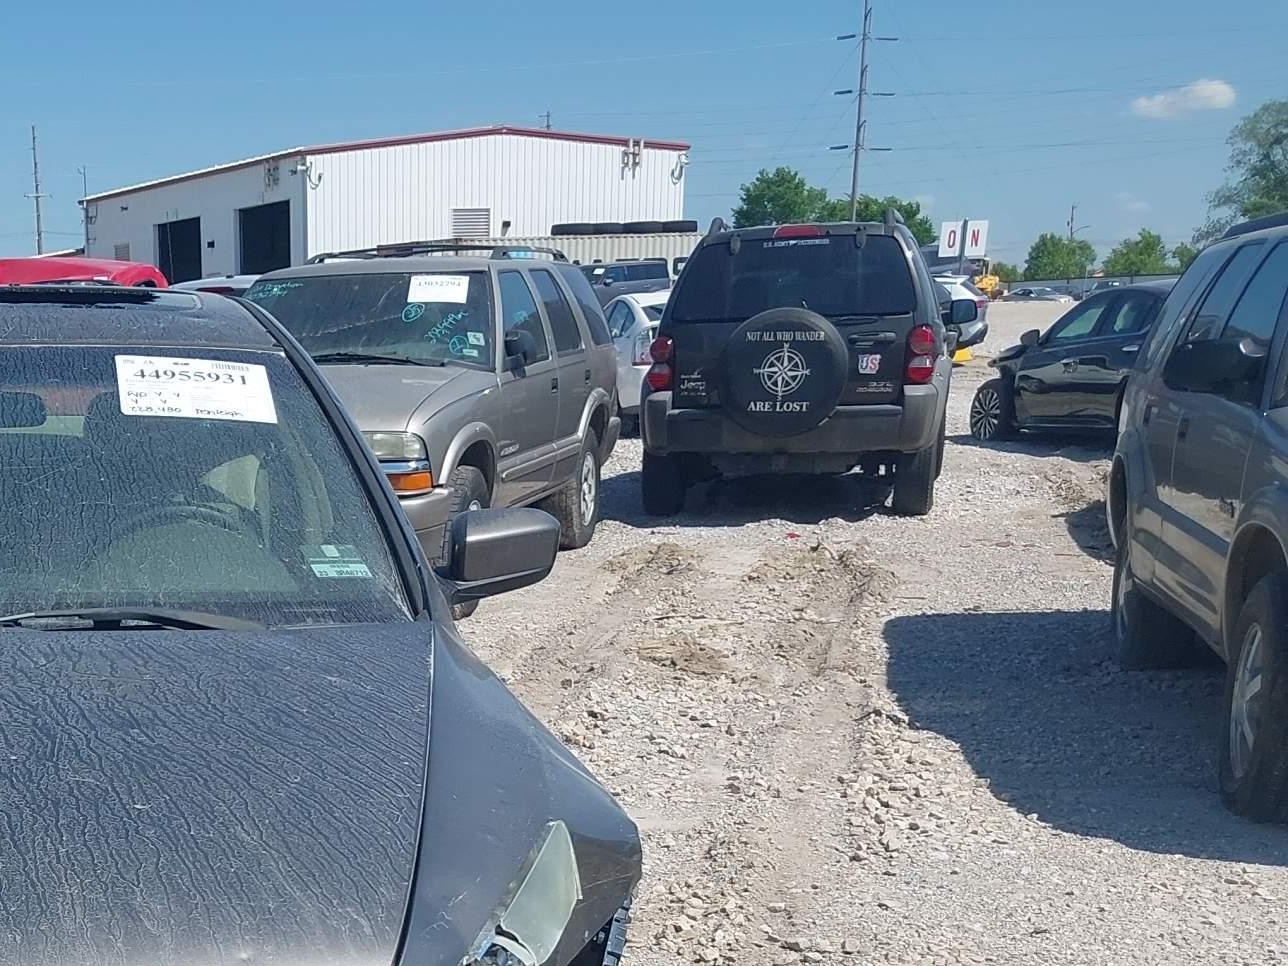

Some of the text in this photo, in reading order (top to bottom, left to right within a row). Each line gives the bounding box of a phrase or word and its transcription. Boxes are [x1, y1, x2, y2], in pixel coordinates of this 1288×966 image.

[970, 229, 980, 247] N
[746, 331, 825, 341] NOT ALL WHO WANDER
[133, 368, 247, 385] 44955931
[747, 401, 810, 412] ARE LOST
